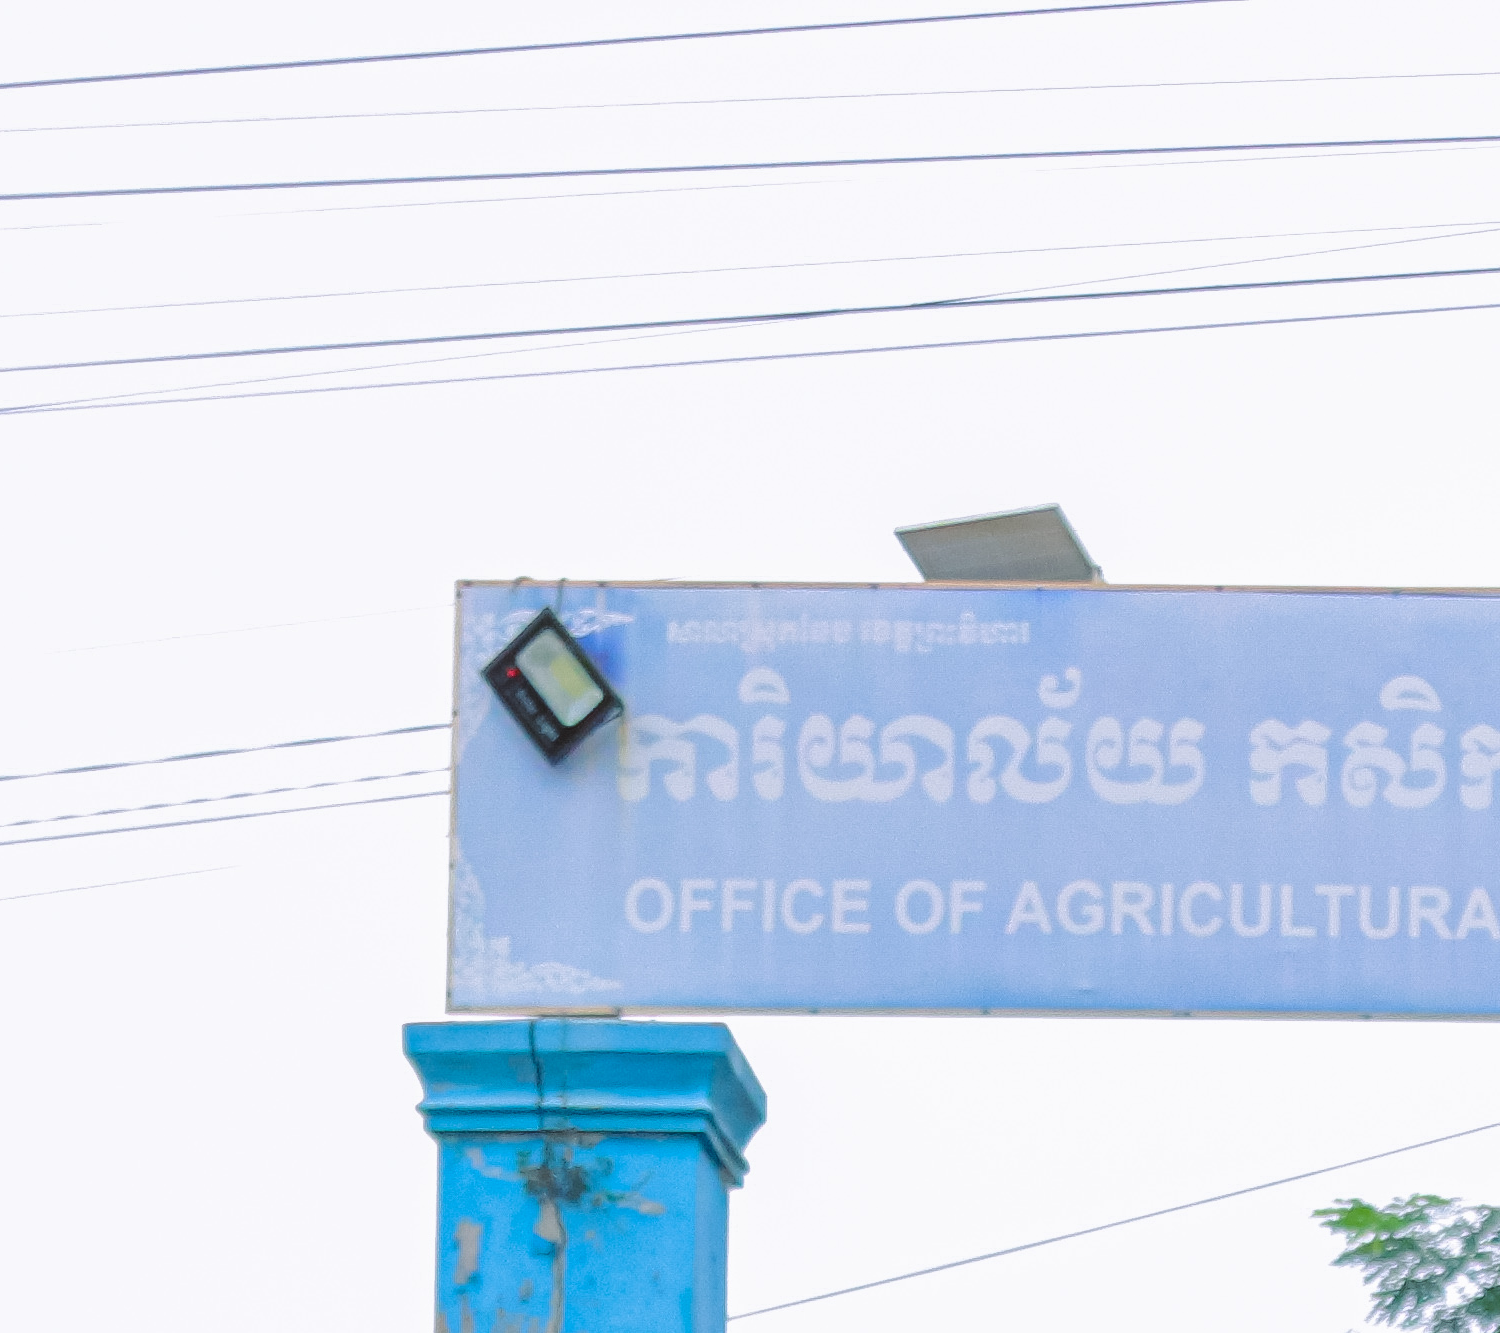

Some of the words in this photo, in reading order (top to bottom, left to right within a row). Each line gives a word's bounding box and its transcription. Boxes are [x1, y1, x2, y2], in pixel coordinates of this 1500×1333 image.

[620, 666, 1205, 806] ការិយាល័យ
[624, 877, 872, 935] OFFICE
[894, 878, 988, 935] OF
